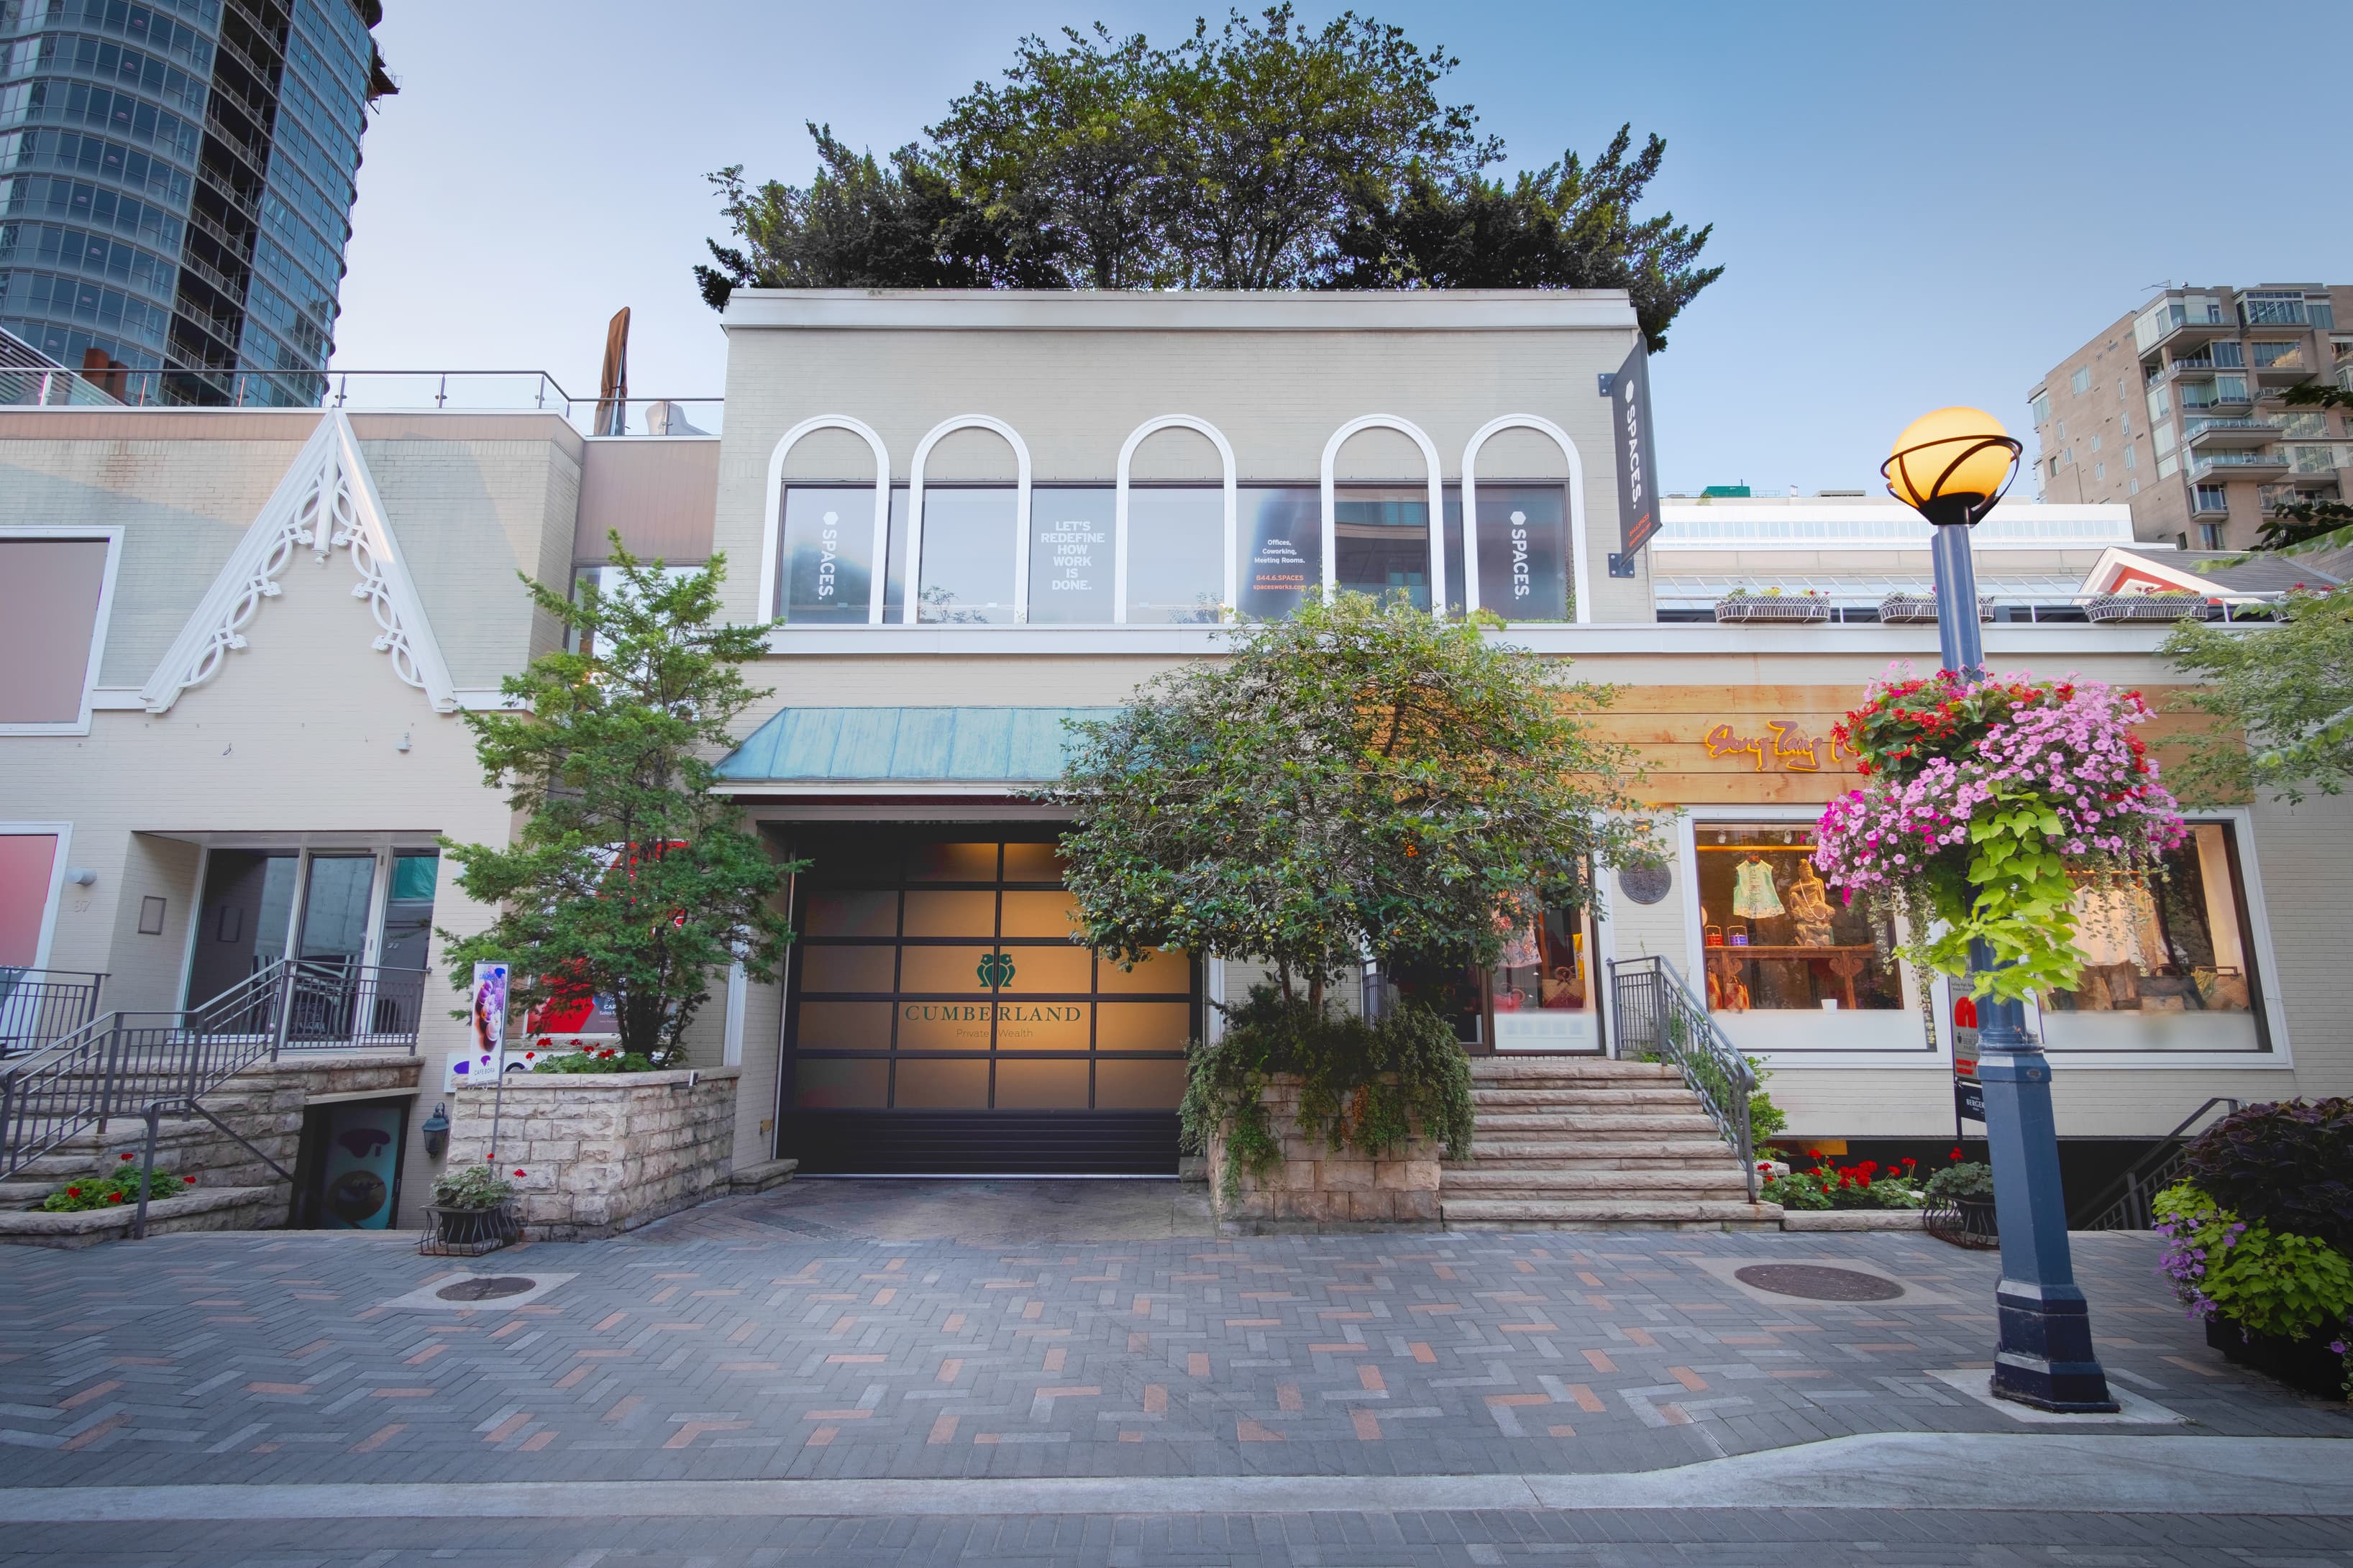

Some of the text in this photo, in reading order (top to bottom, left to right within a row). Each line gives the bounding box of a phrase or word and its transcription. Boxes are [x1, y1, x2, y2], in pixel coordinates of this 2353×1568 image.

[1627, 404, 1641, 510] SPACES.
[1055, 521, 1091, 531] LET'S
[1041, 533, 1105, 543] REDEFINE
[1057, 544, 1088, 555] HOW
[818, 528, 838, 600] SPACES.
[1053, 556, 1092, 567] WORK
[1511, 528, 1530, 600] SPACES.
[1065, 568, 1079, 579] IS
[1052, 579, 1092, 590] DONE.
[1768, 720, 1824, 771] Tang
[905, 1005, 1081, 1022] CUMBERLAND
[956, 1029, 1033, 1037] Private Wealth
